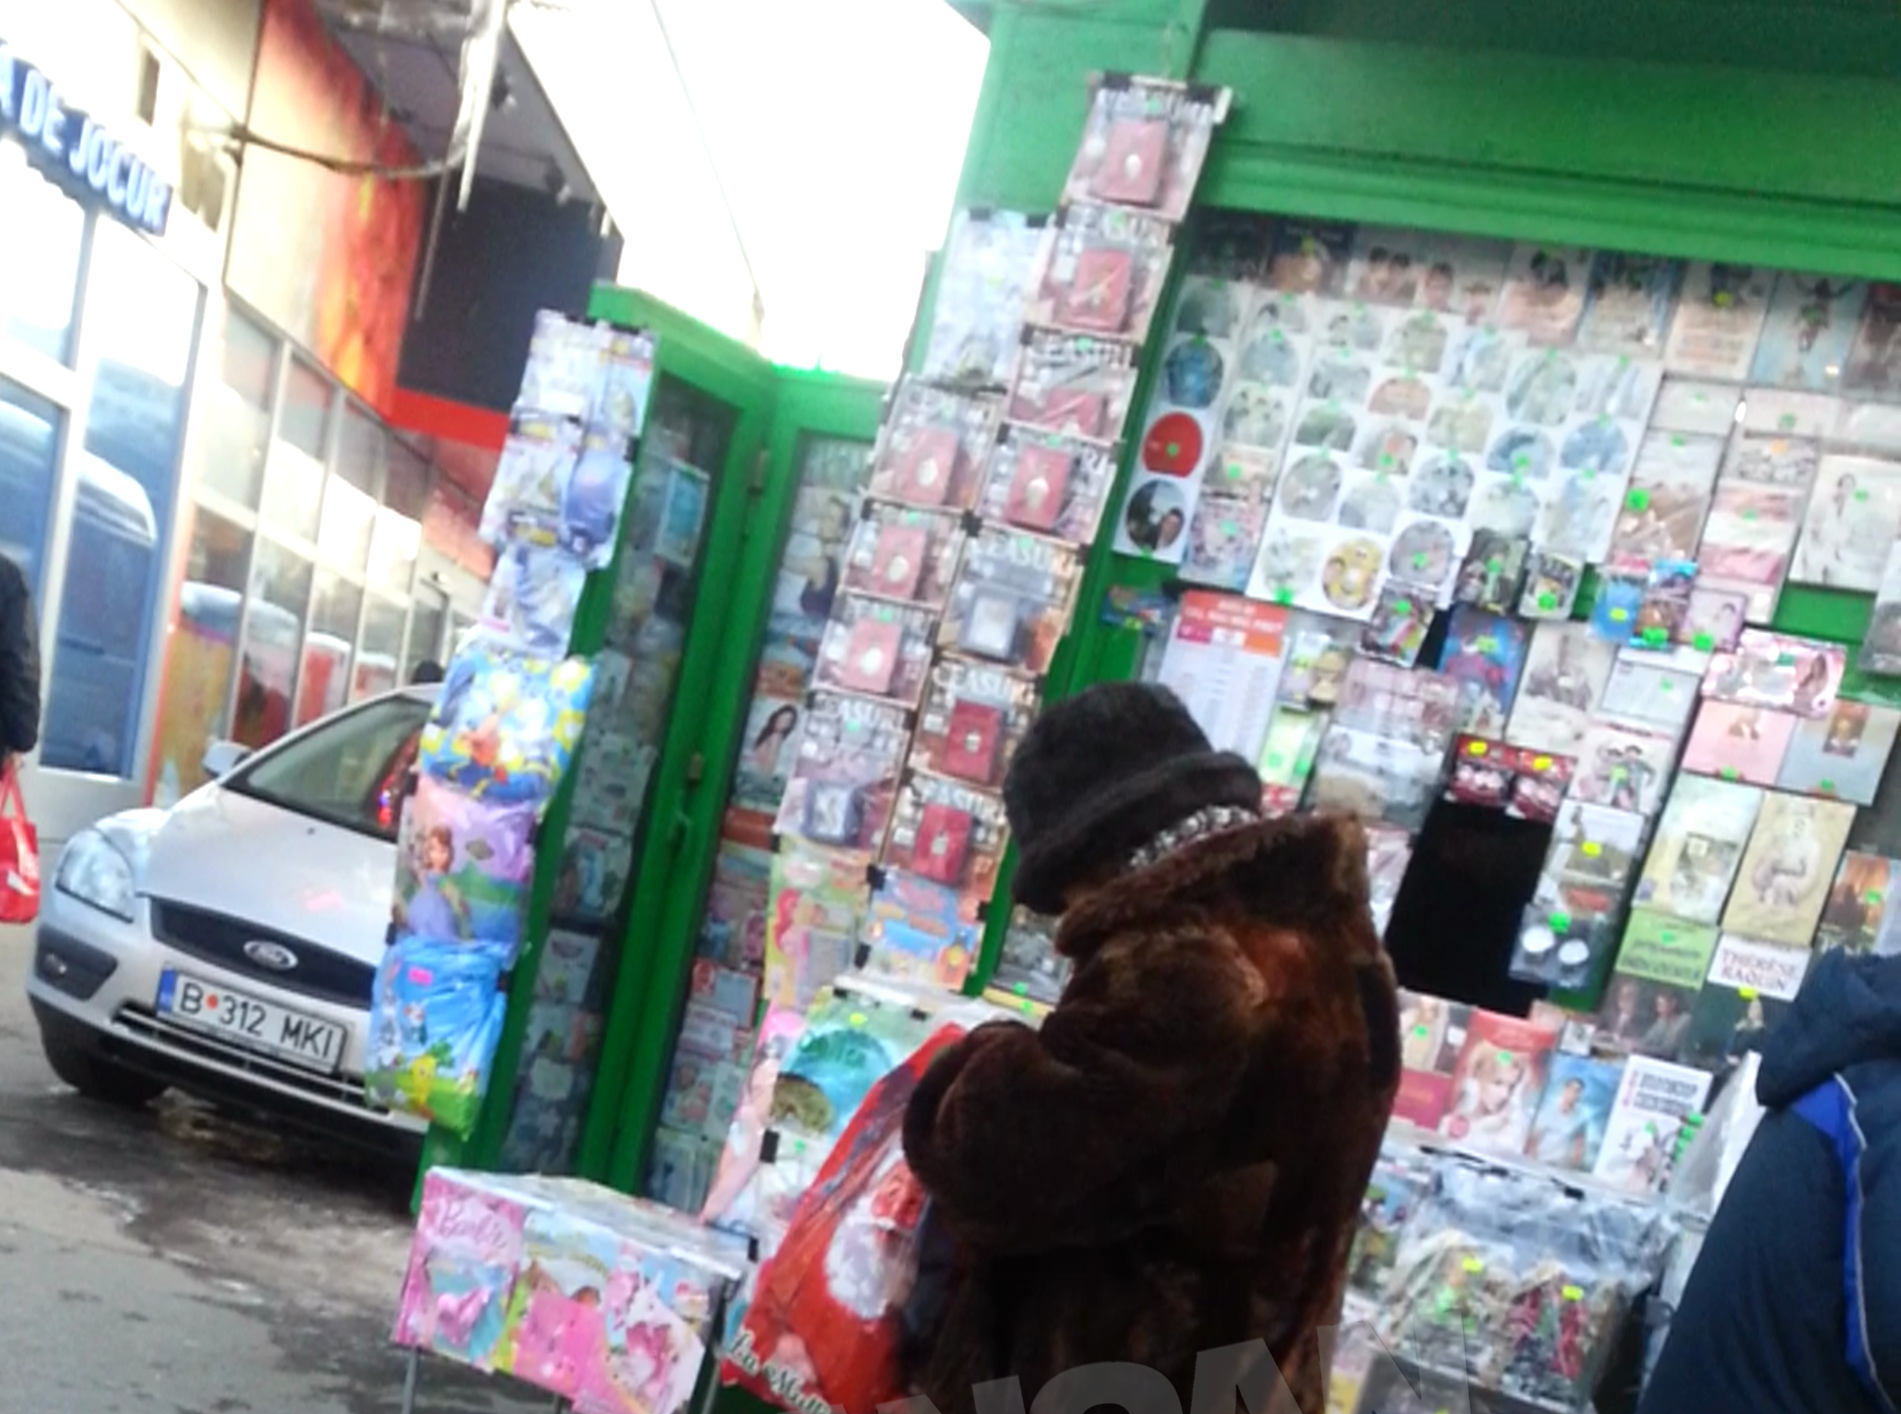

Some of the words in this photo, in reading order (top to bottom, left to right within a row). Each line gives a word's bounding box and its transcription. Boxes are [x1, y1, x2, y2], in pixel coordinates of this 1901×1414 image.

[19, 68, 66, 156] DE
[69, 116, 169, 229] JOCUR
[179, 981, 204, 1015] B
[219, 994, 267, 1037] 312
[279, 1014, 334, 1058] MKI
